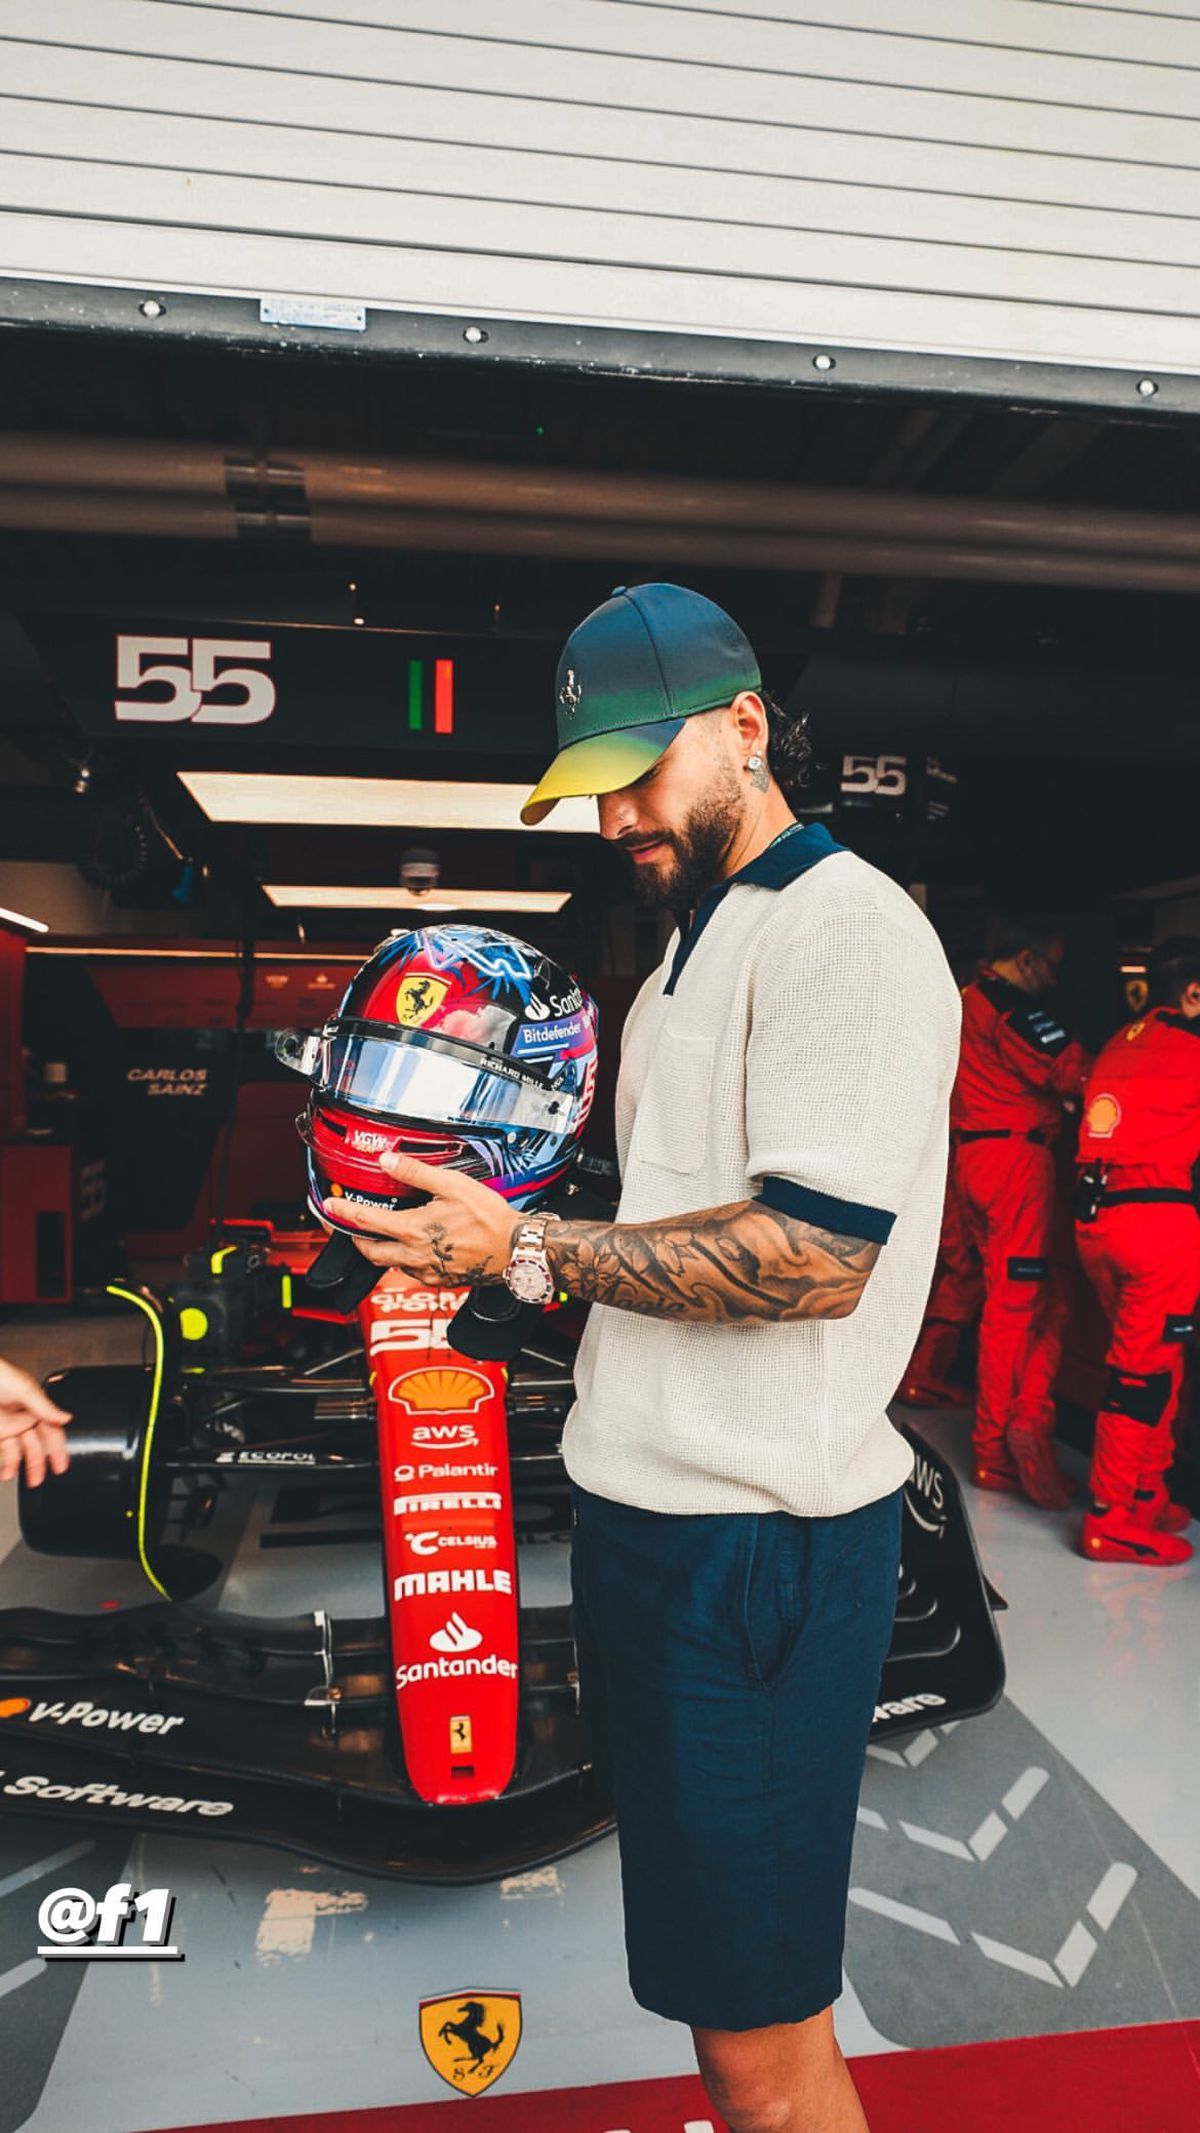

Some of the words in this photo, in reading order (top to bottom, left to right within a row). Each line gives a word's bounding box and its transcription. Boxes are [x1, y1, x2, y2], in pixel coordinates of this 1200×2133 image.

[114, 635, 276, 725] 55
[840, 755, 907, 796] 55
[523, 1021, 582, 1044] Bitdefender
[127, 1067, 208, 1081] CARLOS
[147, 1083, 208, 1096] SAINZ
[412, 1425, 476, 1440] aws
[418, 1463, 498, 1478] Palantir
[394, 1491, 502, 1516] PIRELLI
[394, 1569, 512, 1602] MAHLE
[395, 1653, 518, 1690] Santander
[28, 1701, 185, 1735] V-Power
[4, 1775, 234, 1816] Software
